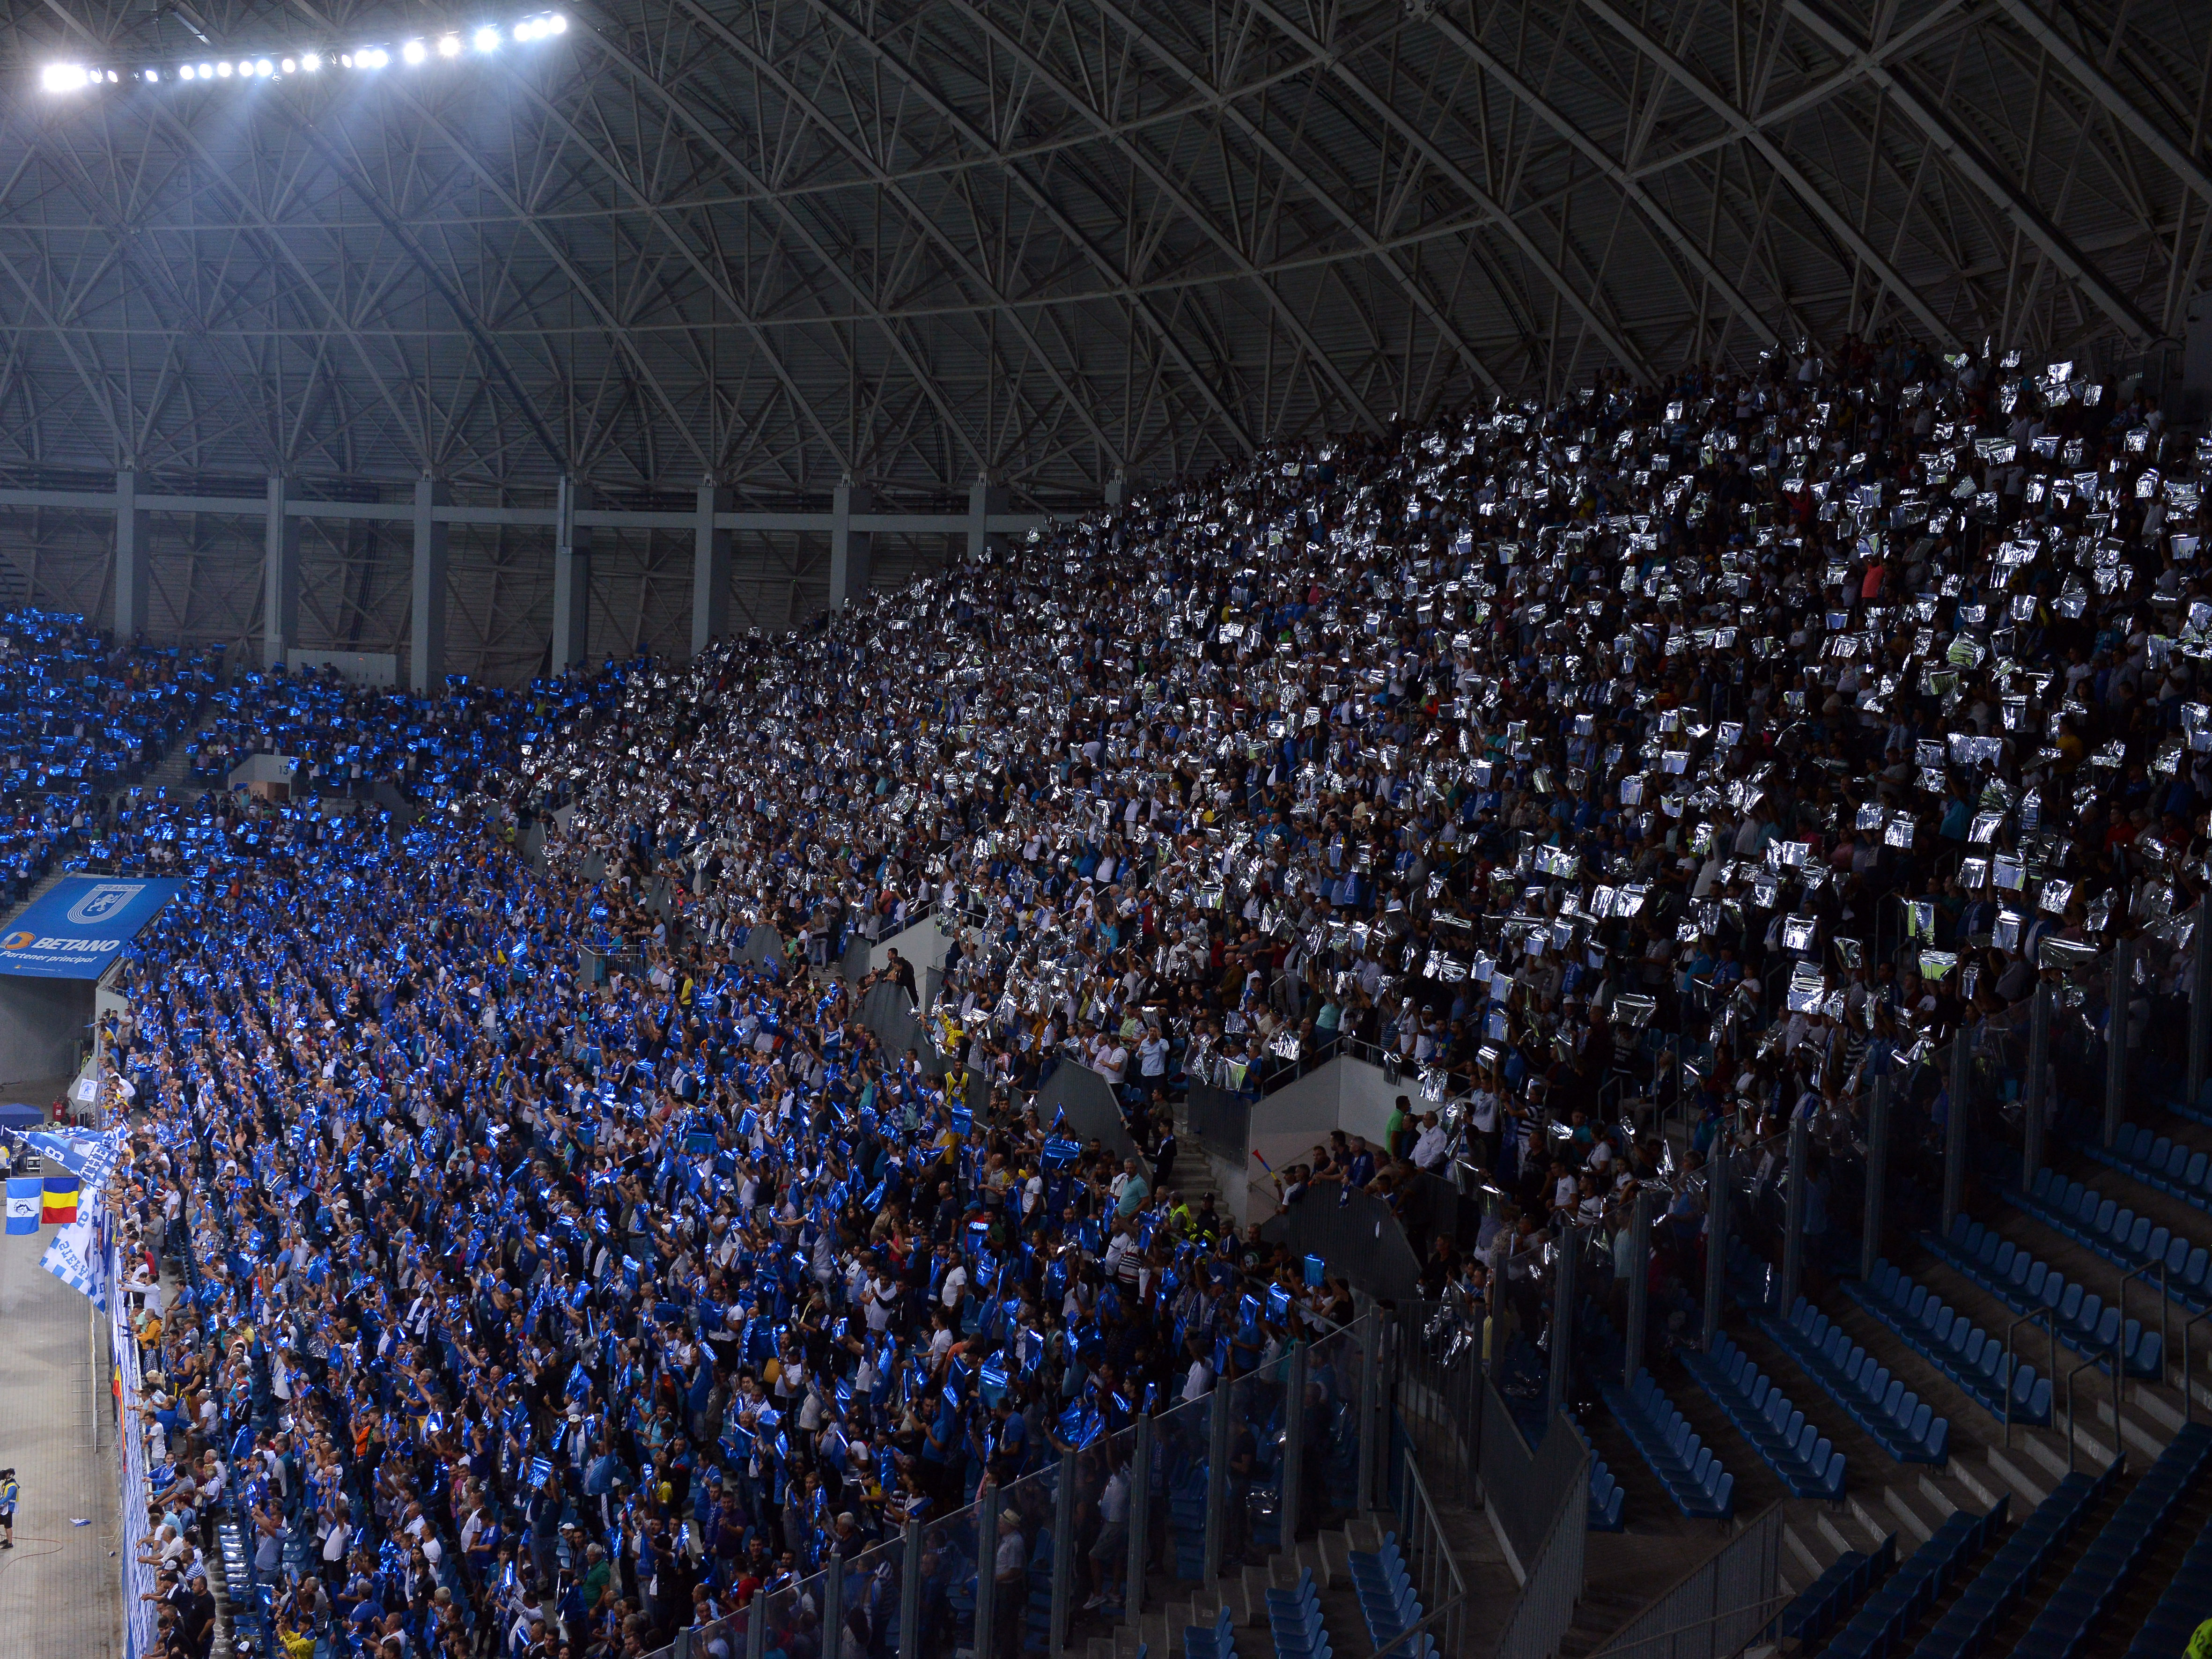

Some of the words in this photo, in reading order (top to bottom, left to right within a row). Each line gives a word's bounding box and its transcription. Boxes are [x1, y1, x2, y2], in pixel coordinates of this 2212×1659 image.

[279, 765, 289, 775] 13
[31, 937, 120, 952] BETANO
[0, 951, 49, 961] Partener
[46, 956, 97, 964] principal
[80, 1146, 109, 1179] THE
